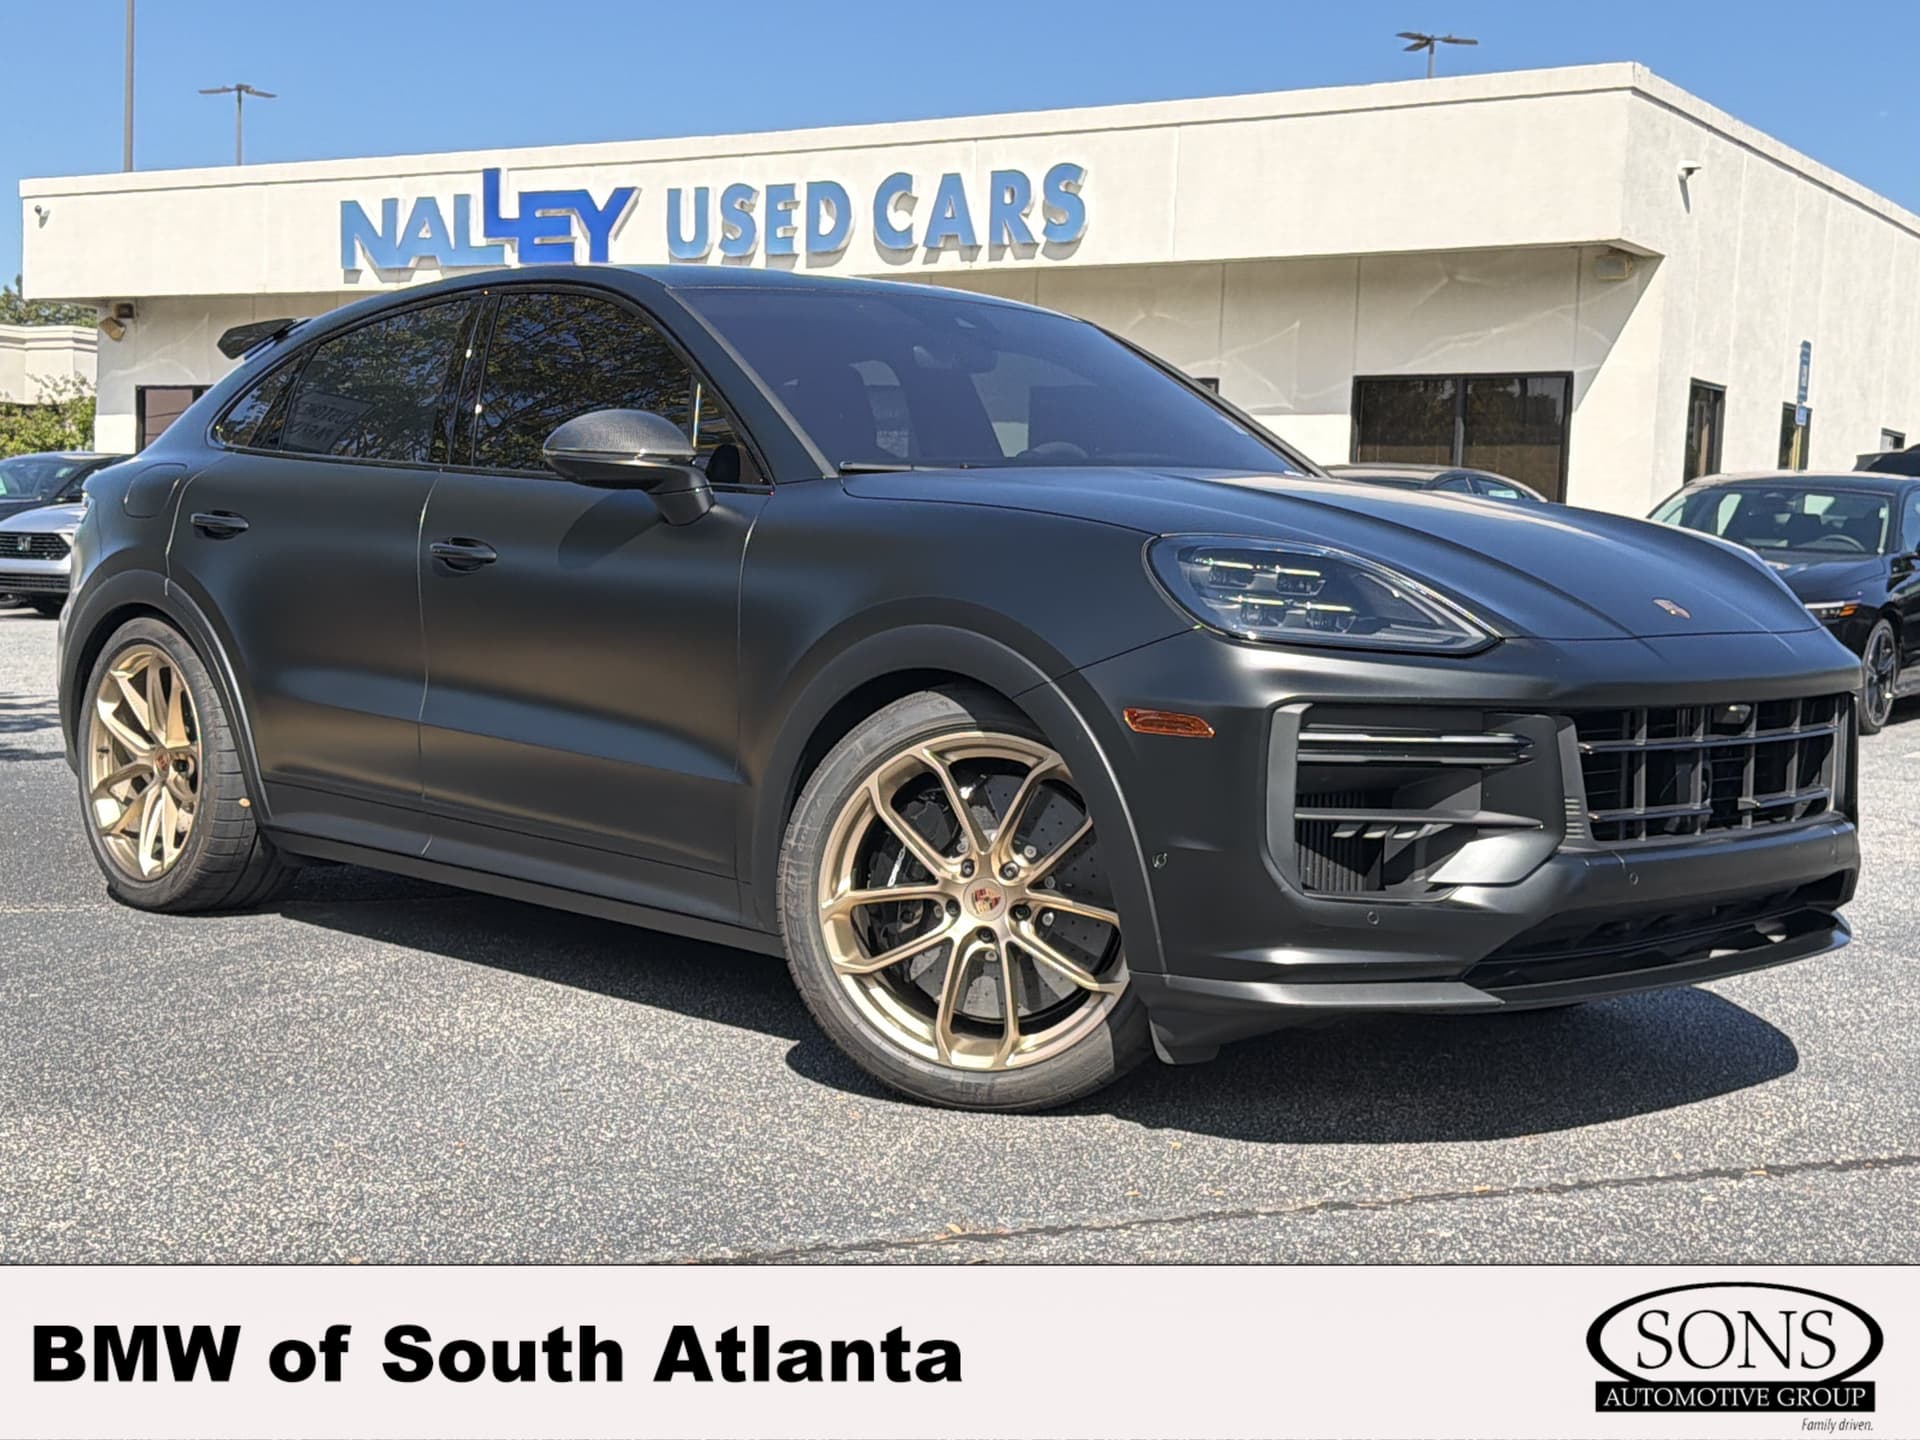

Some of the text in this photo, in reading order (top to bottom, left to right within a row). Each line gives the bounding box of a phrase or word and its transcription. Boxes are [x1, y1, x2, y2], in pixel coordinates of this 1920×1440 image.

[340, 162, 1088, 266] NALLEY USED CARS
